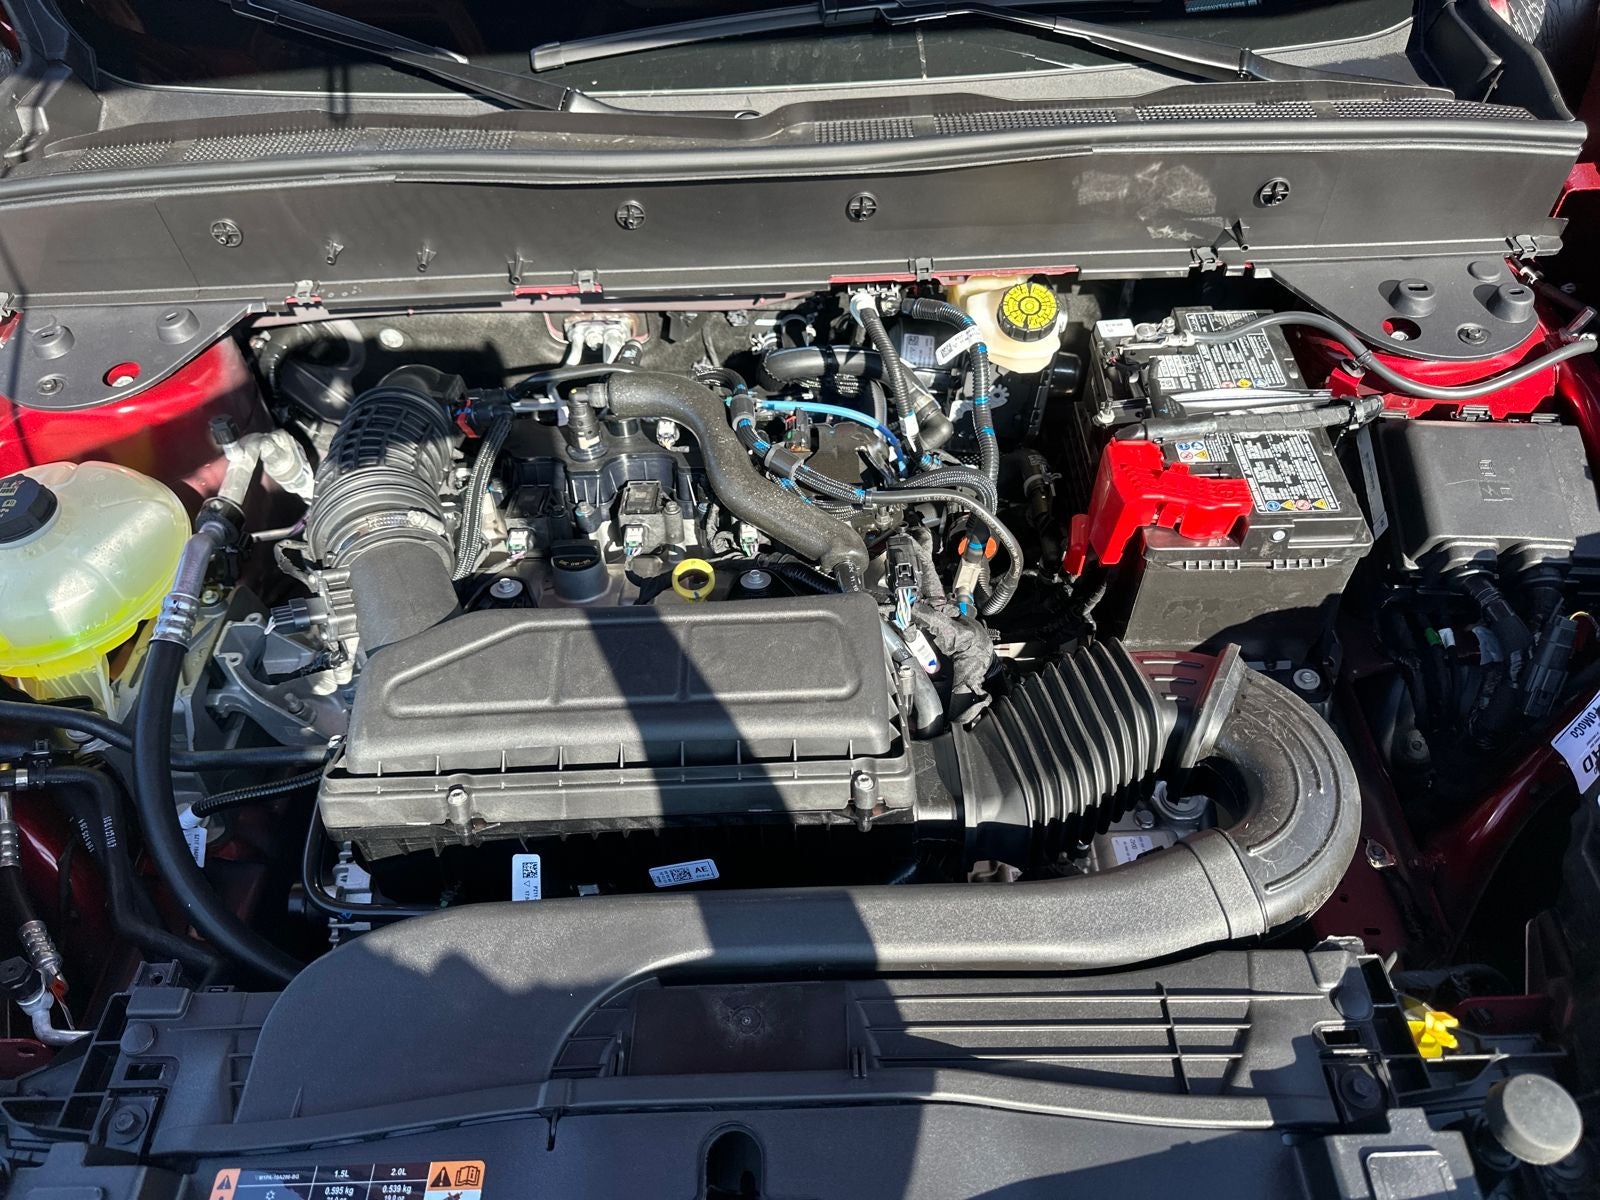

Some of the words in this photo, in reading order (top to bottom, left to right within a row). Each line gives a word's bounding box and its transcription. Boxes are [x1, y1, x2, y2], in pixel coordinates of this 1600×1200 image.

[695, 865, 709, 874] AE
[334, 1169, 350, 1178] 1.5L
[390, 1167, 407, 1176] 2.0L
[324, 1186, 344, 1195] 0.595
[344, 1185, 355, 1197] kg
[382, 1184, 402, 1194] 0.539
[402, 1184, 412, 1195] kg
